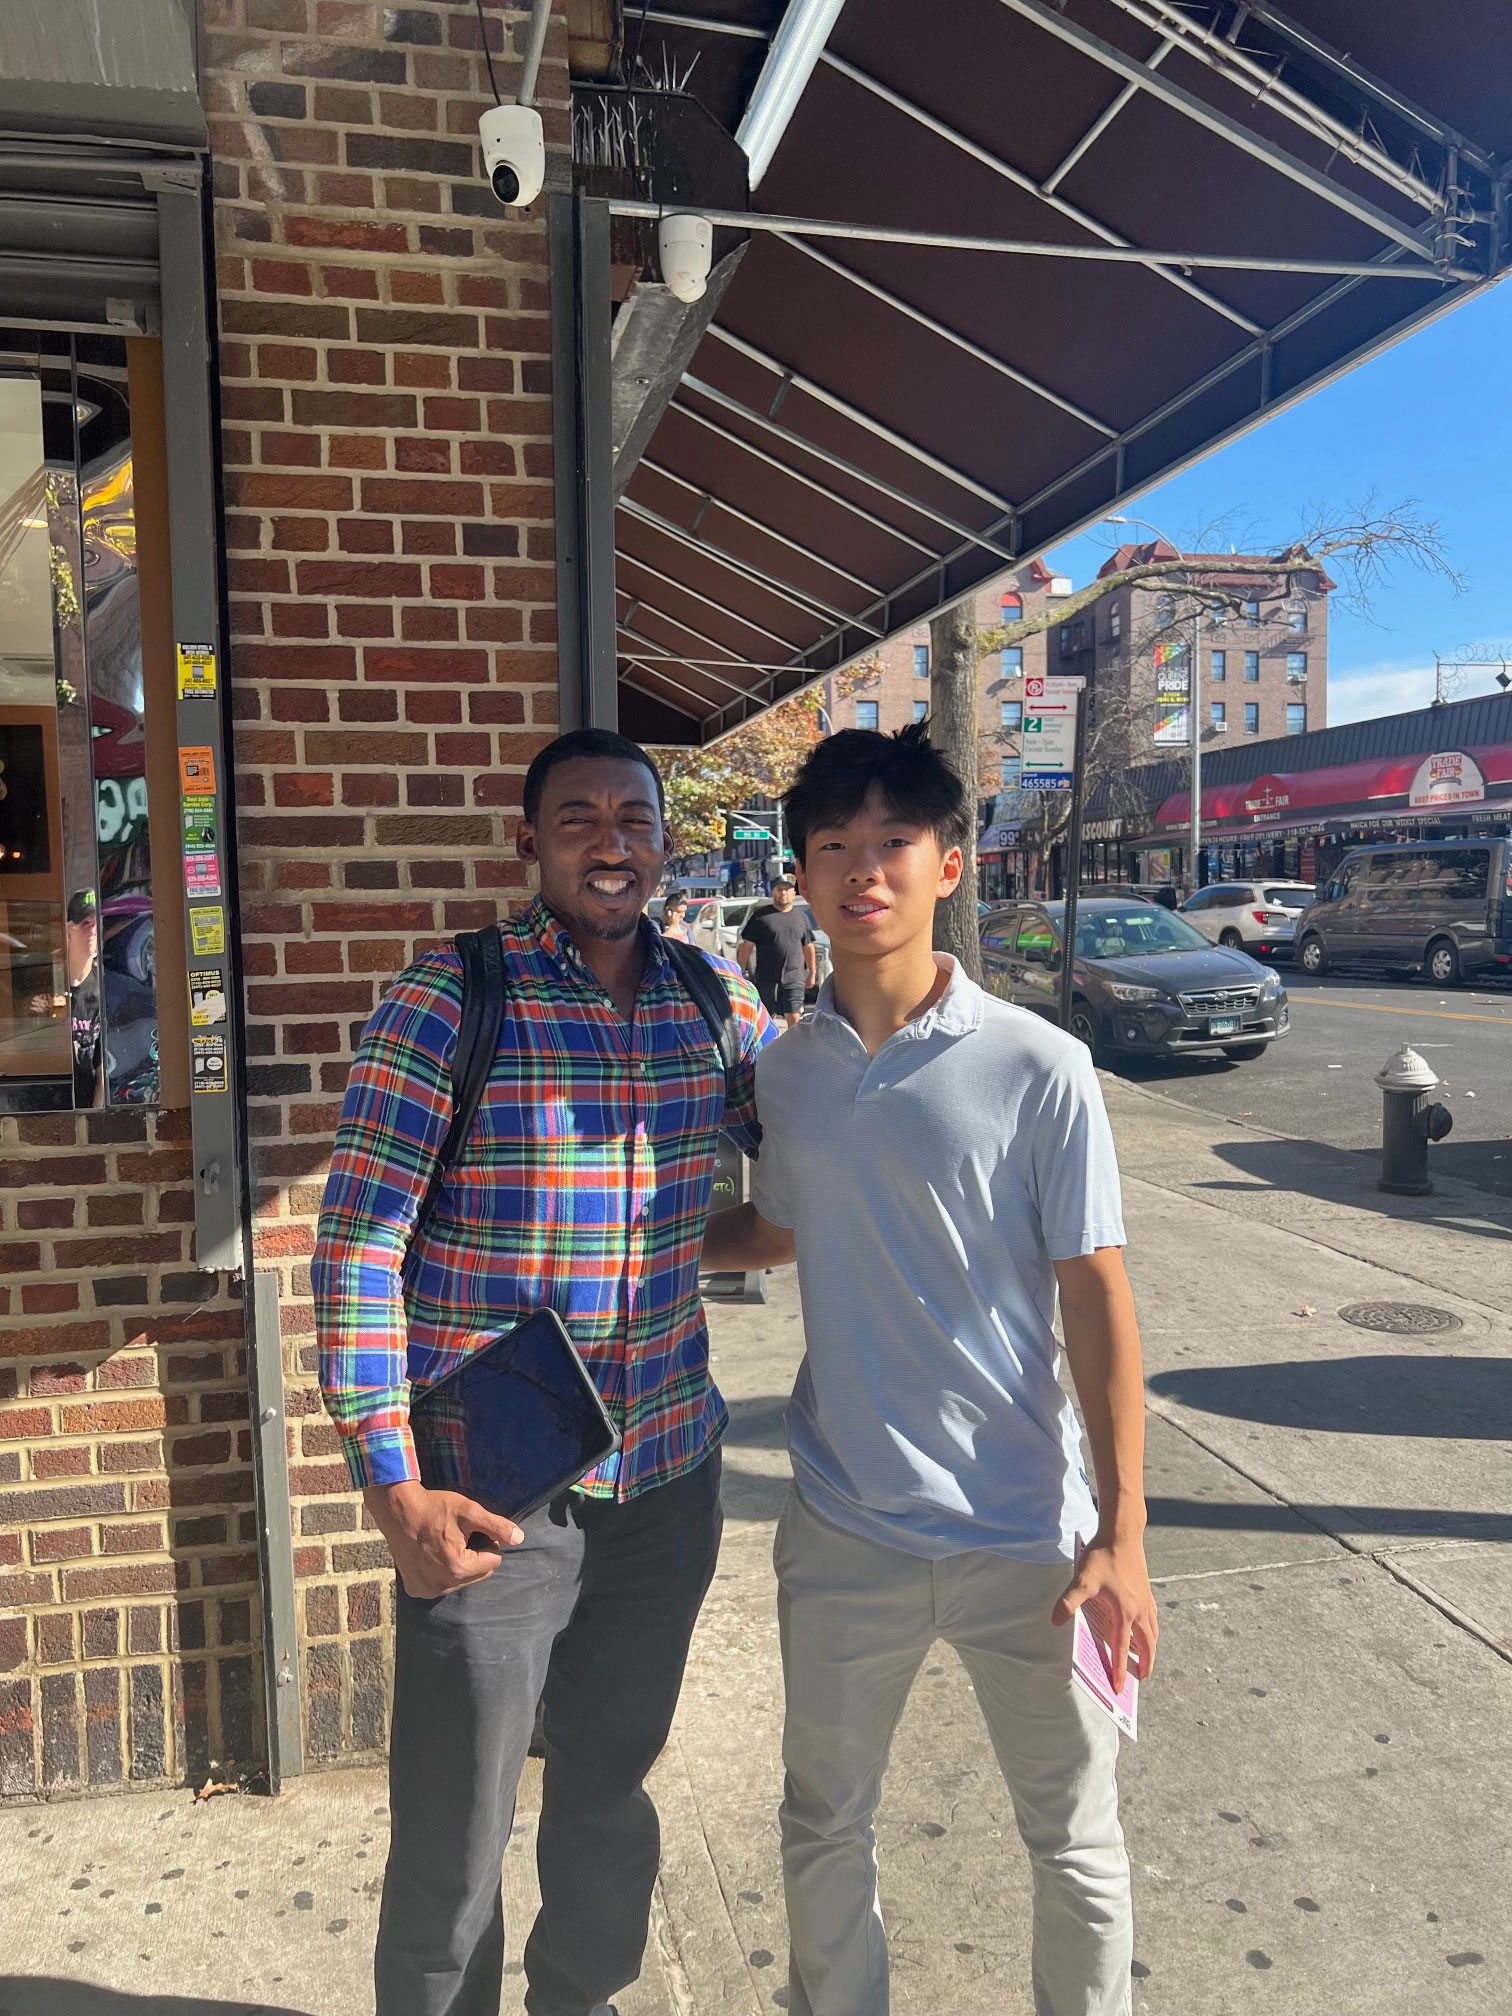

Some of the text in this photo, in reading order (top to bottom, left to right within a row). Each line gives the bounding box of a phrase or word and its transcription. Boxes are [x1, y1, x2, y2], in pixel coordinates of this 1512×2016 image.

[1157, 671, 1189, 681] QUEENS
[1157, 681, 1189, 690] PRIDE
[1027, 717, 1038, 731] 2
[1431, 755, 1462, 769] TRADE
[1436, 767, 1455, 779] FAIR
[1022, 779, 1057, 788] 465585
[1245, 795, 1289, 811] TRADE FAIR
[1414, 795, 1429, 804] BEST
[1430, 793, 1452, 803] PRICES
[1461, 790, 1480, 798] TOWN
[1253, 812, 1281, 823] ENTRANCE
[1395, 818, 1415, 826] WEEKLY
[1417, 817, 1441, 825] SPECIAL
[1472, 814, 1490, 822] FRESH
[1493, 812, 1511, 821] MEAT
[1081, 818, 1123, 841] ISCOUNT
[1255, 830, 1283, 840] DELIVERY
